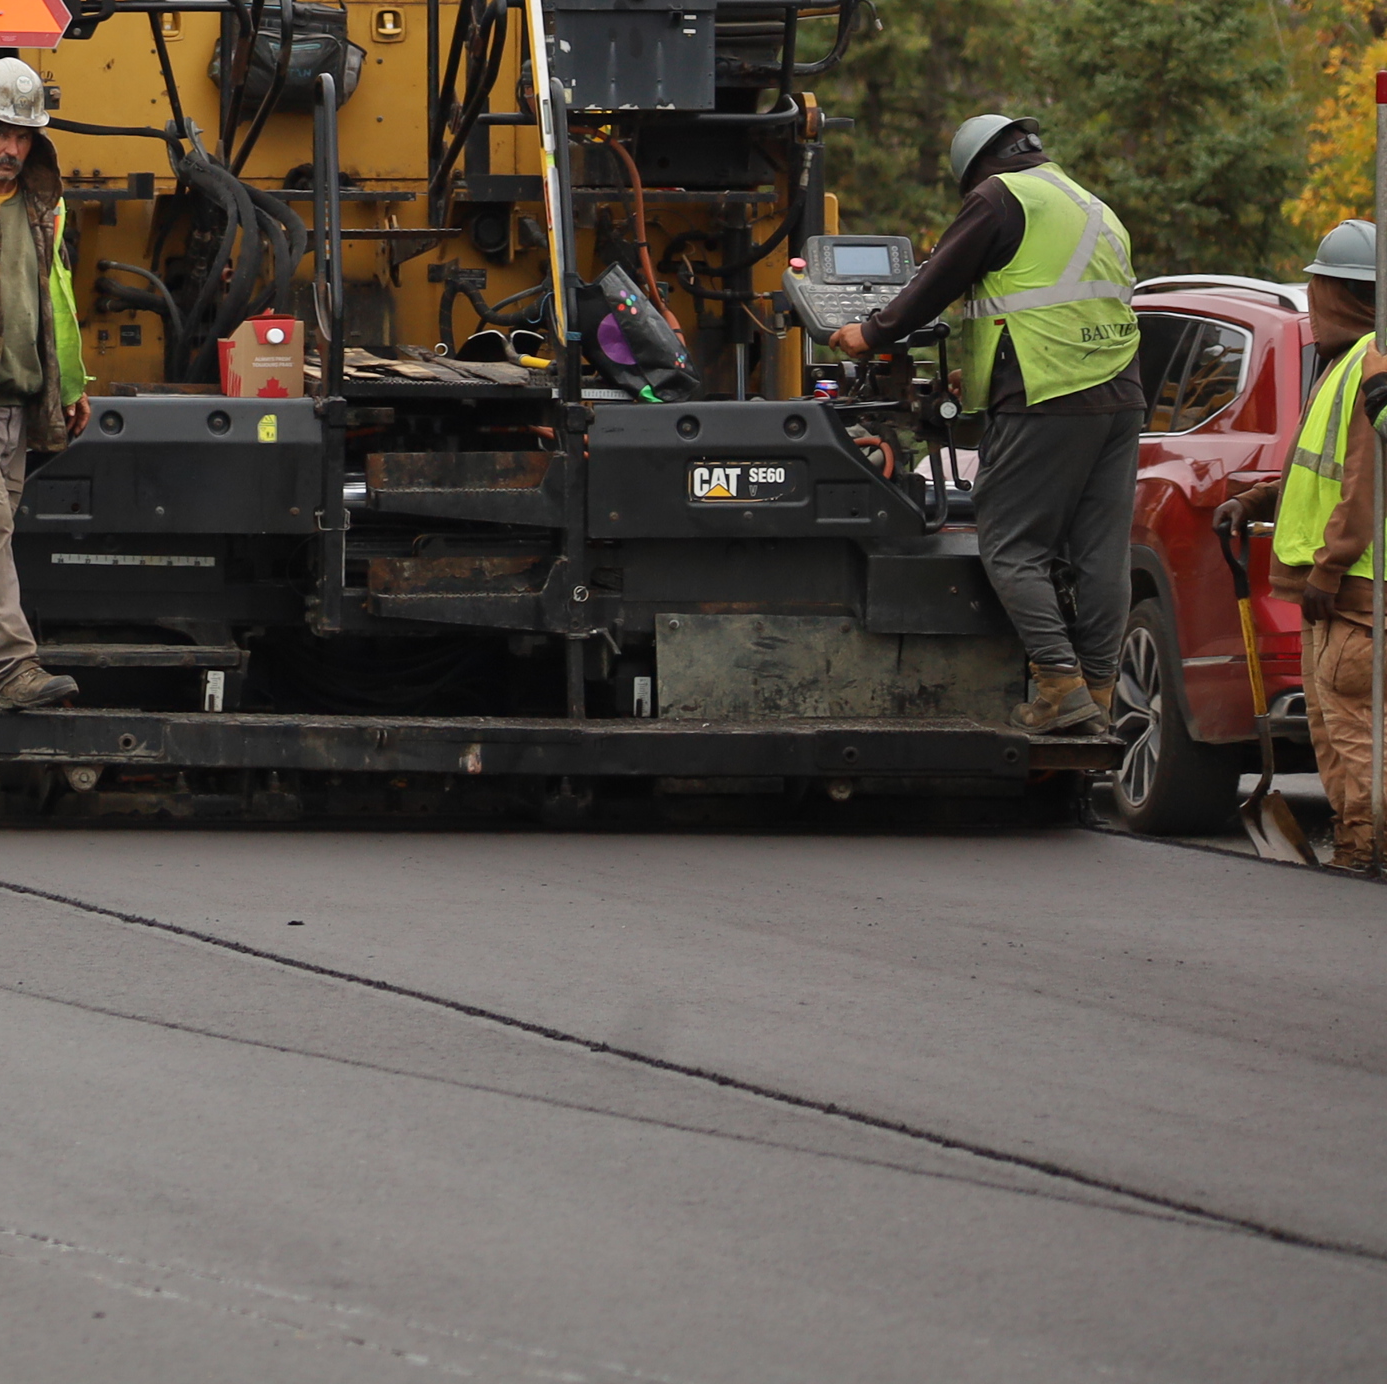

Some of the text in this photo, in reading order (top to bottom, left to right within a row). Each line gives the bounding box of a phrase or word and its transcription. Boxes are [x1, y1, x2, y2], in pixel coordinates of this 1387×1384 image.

[1080, 323, 1137, 343] BAYVIE
[693, 467, 785, 497] CAT SE60
